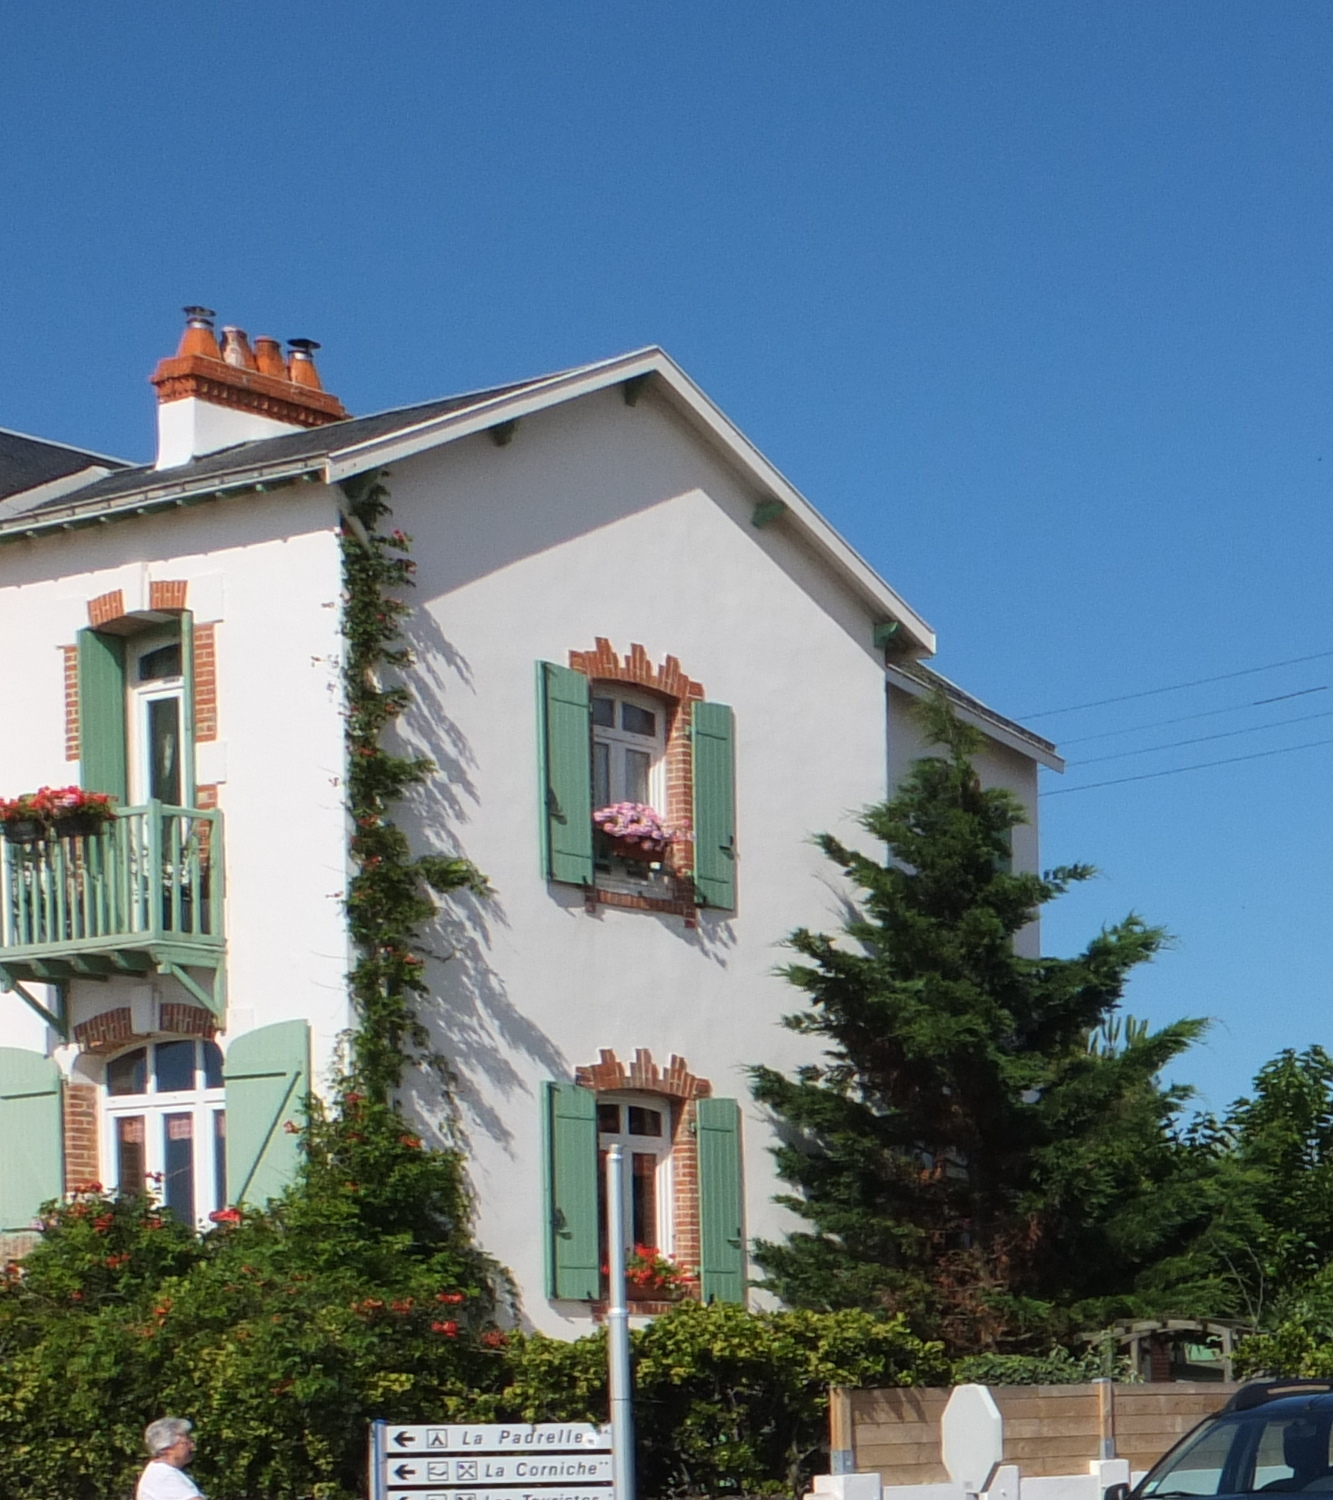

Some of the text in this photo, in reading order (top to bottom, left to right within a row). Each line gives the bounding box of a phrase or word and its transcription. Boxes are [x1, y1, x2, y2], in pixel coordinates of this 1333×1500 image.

[462, 1428, 584, 1446] La Padrelle
[485, 1461, 598, 1478] La Corniche
